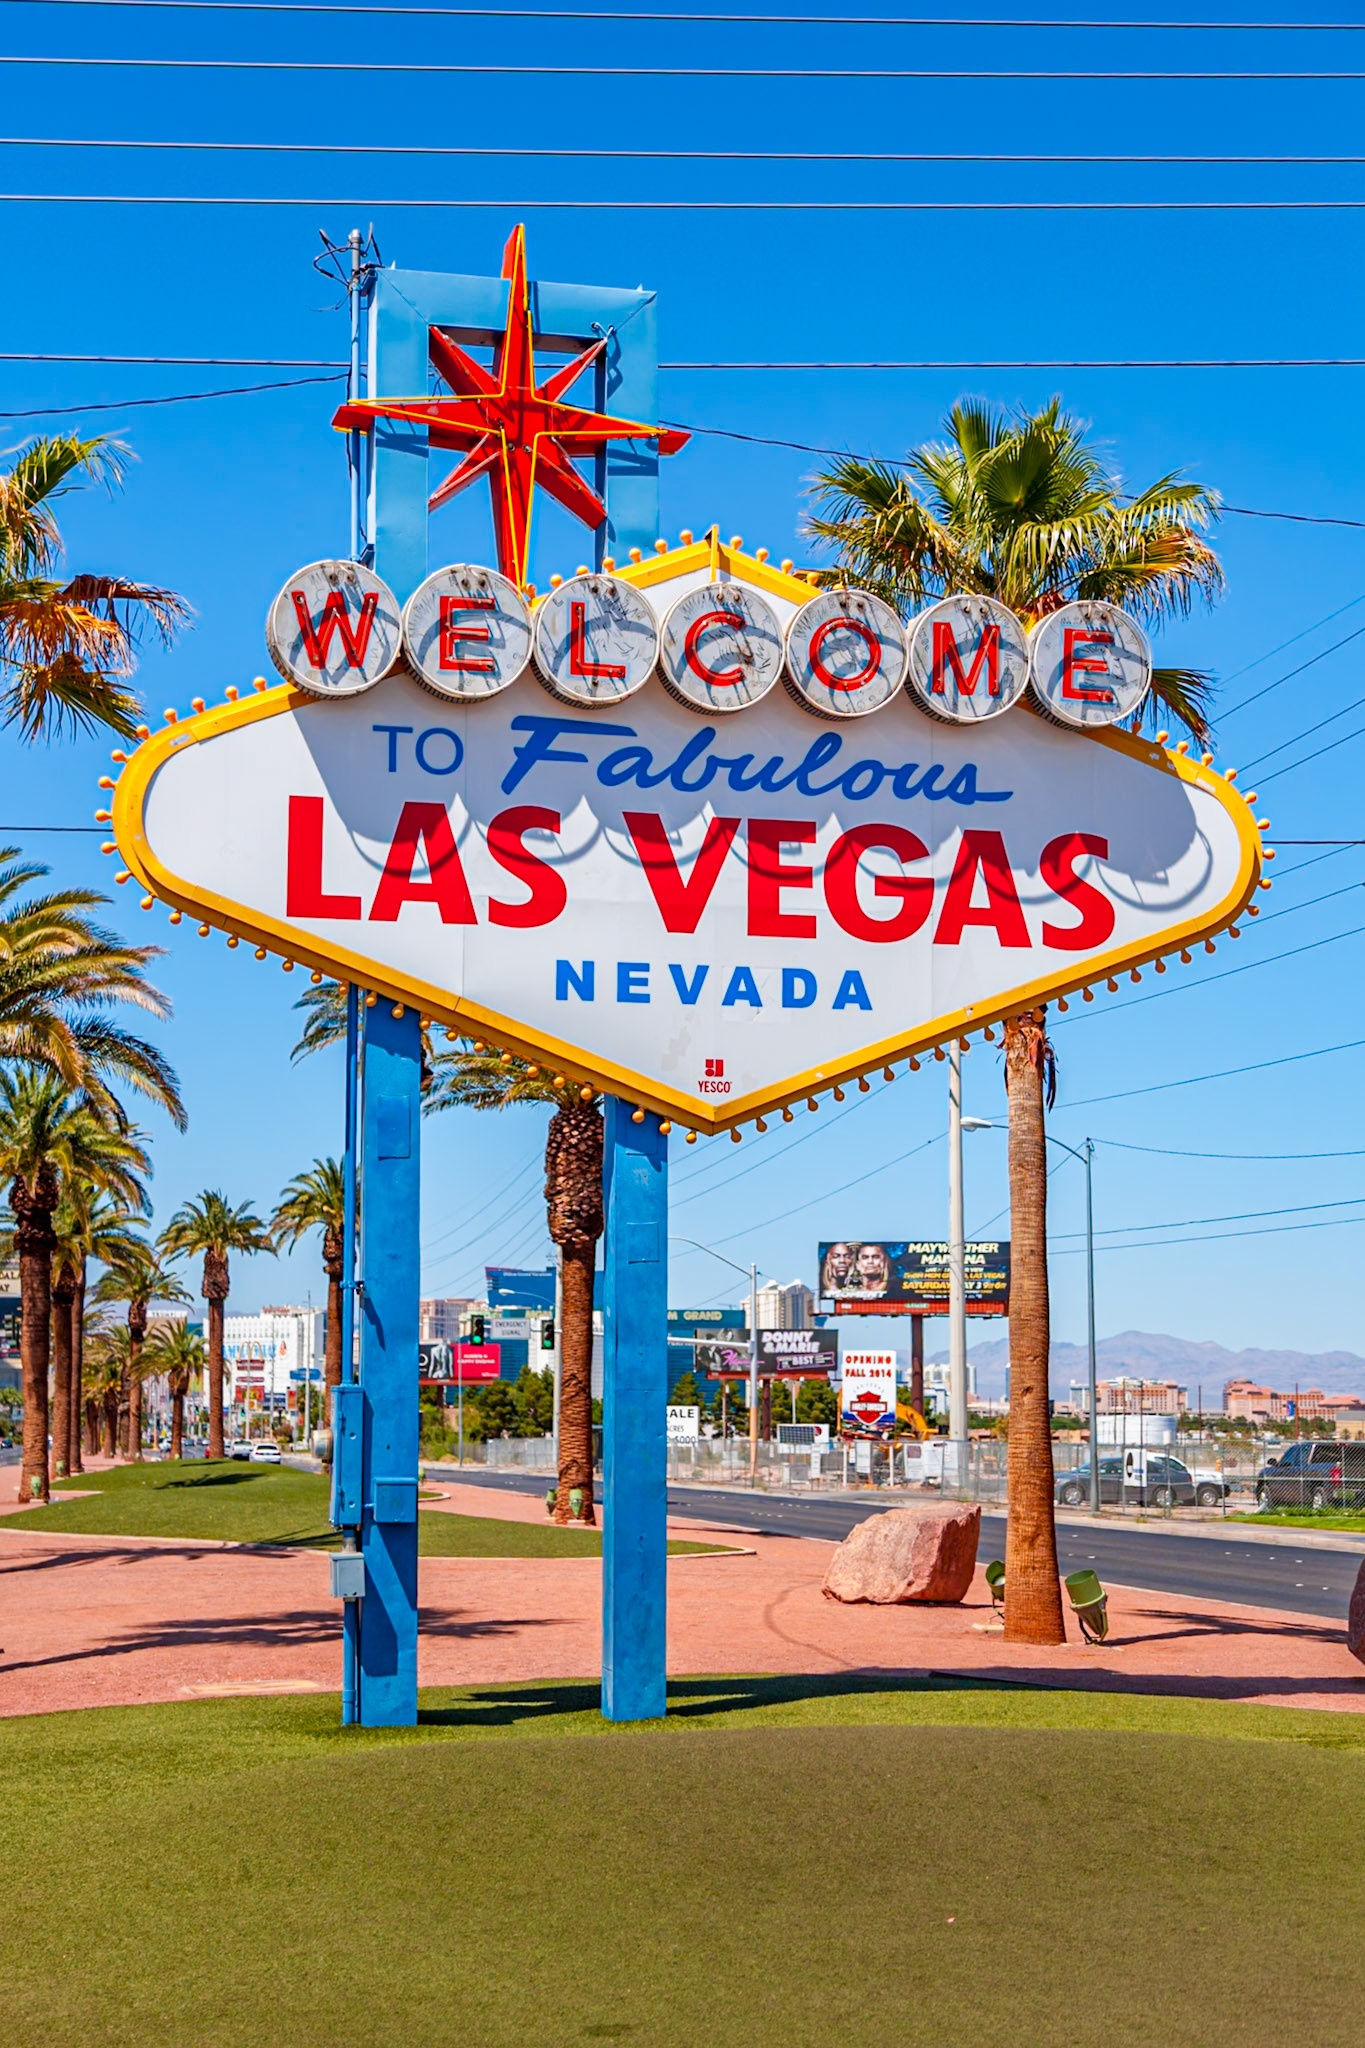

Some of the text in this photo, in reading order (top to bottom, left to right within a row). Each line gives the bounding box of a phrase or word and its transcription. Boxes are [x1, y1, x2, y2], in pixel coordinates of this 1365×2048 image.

[291, 590, 1116, 704] WELCOME
[372, 715, 1014, 805] TO Fabulous
[286, 795, 1116, 951] LAS VEGAS
[555, 959, 873, 1011] NEVADA
[698, 1080, 731, 1093] YESCO
[908, 1243, 999, 1253] MAYWTHER
[921, 1254, 986, 1265] MAINA
[902, 1281, 951, 1290] SATURDAY
[683, 1311, 723, 1320] GRAND
[761, 1331, 814, 1343] DONNY
[792, 1355, 814, 1366] BEST
[845, 1355, 891, 1364] OPENING
[845, 1369, 892, 1378] FALL 2014
[667, 1408, 695, 1418] ALE
